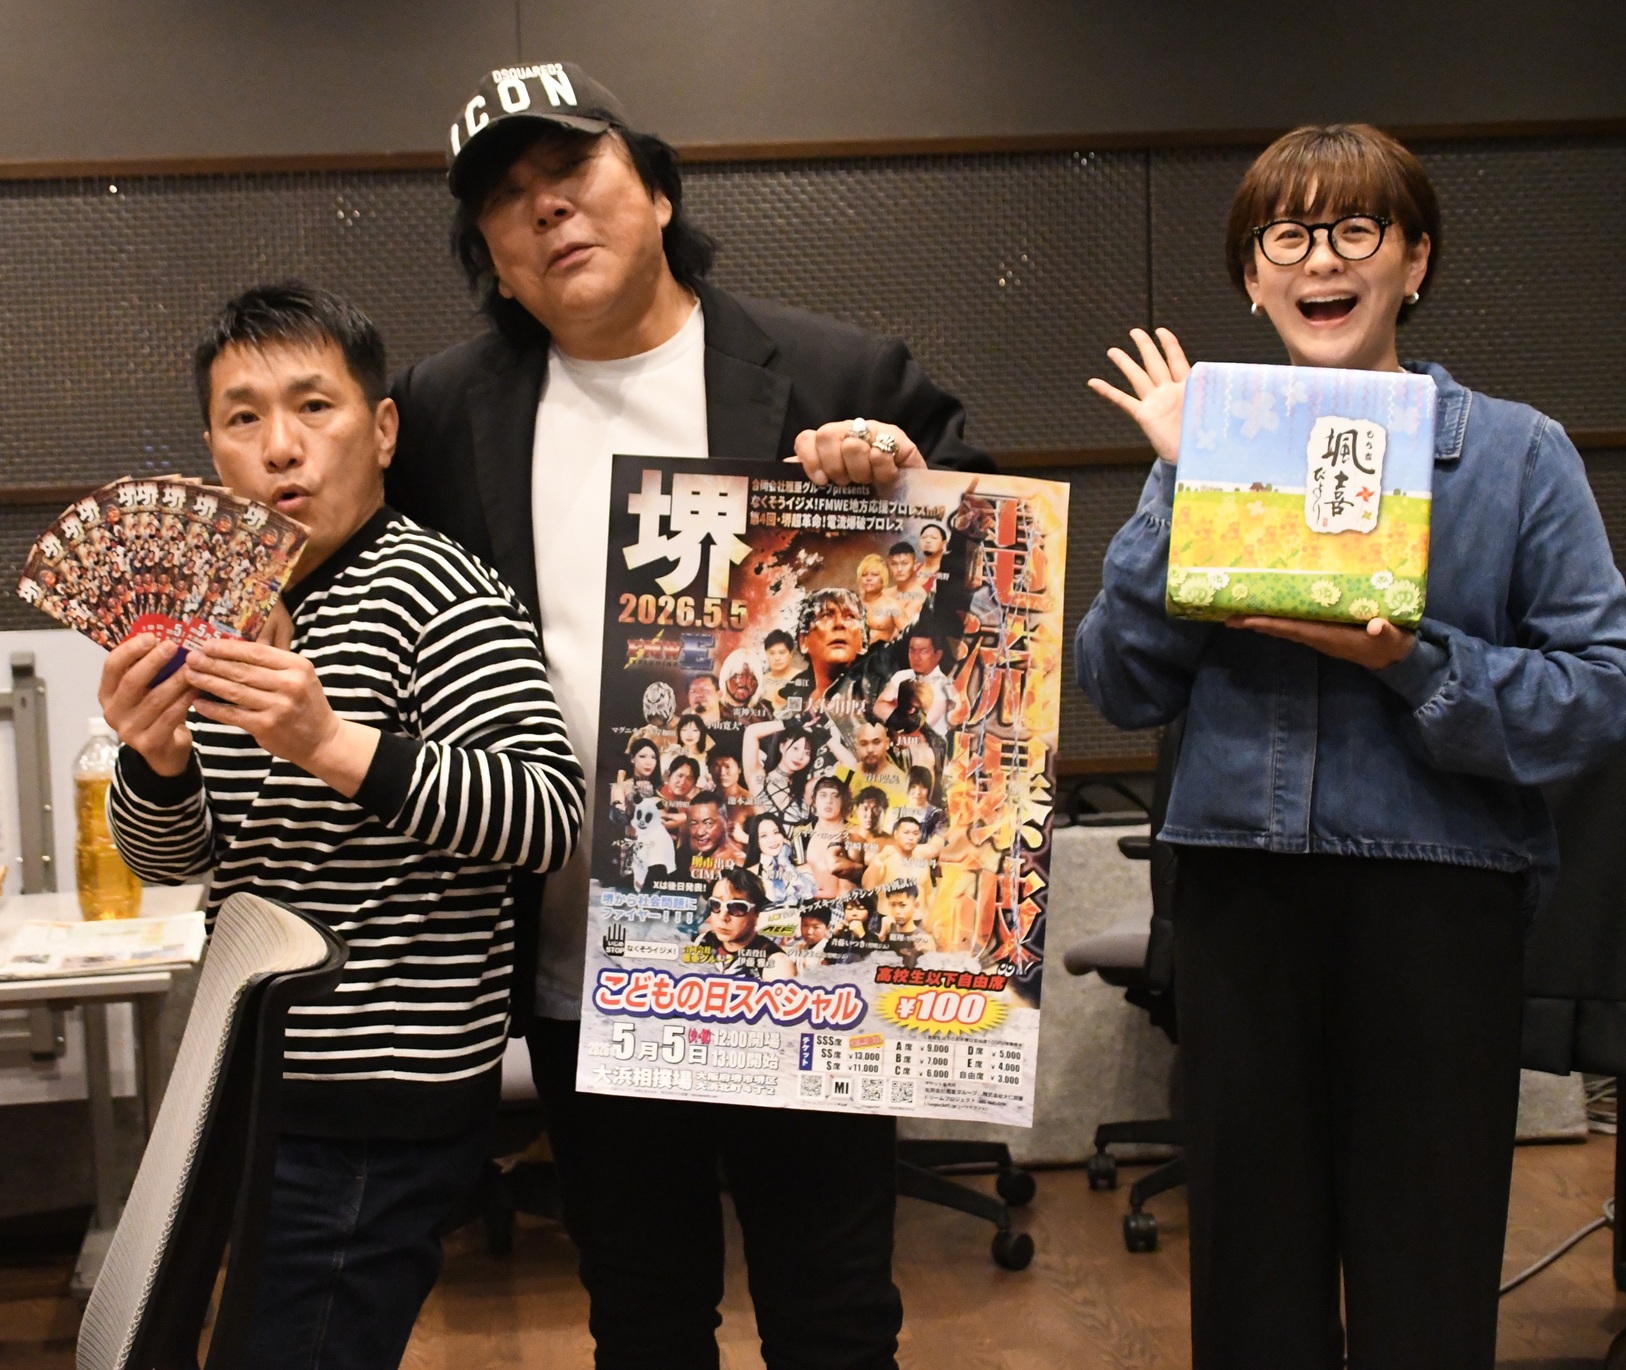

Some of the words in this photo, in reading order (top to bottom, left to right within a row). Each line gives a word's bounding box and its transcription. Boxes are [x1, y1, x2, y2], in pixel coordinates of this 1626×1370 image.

[622, 469, 753, 599] 堺
[618, 593, 749, 631] 2026.5.5
[690, 869, 723, 880] CIMA
[601, 891, 698, 911] 堺から社会問題に
[606, 946, 625, 954] STOP
[877, 967, 1006, 990] 高校生以下自由席
[598, 972, 863, 1024] こどもの日スペシャル
[897, 990, 986, 1024] ¥100
[801, 1037, 811, 1066] チケット
[592, 1066, 693, 1091] 大浜相撲場
